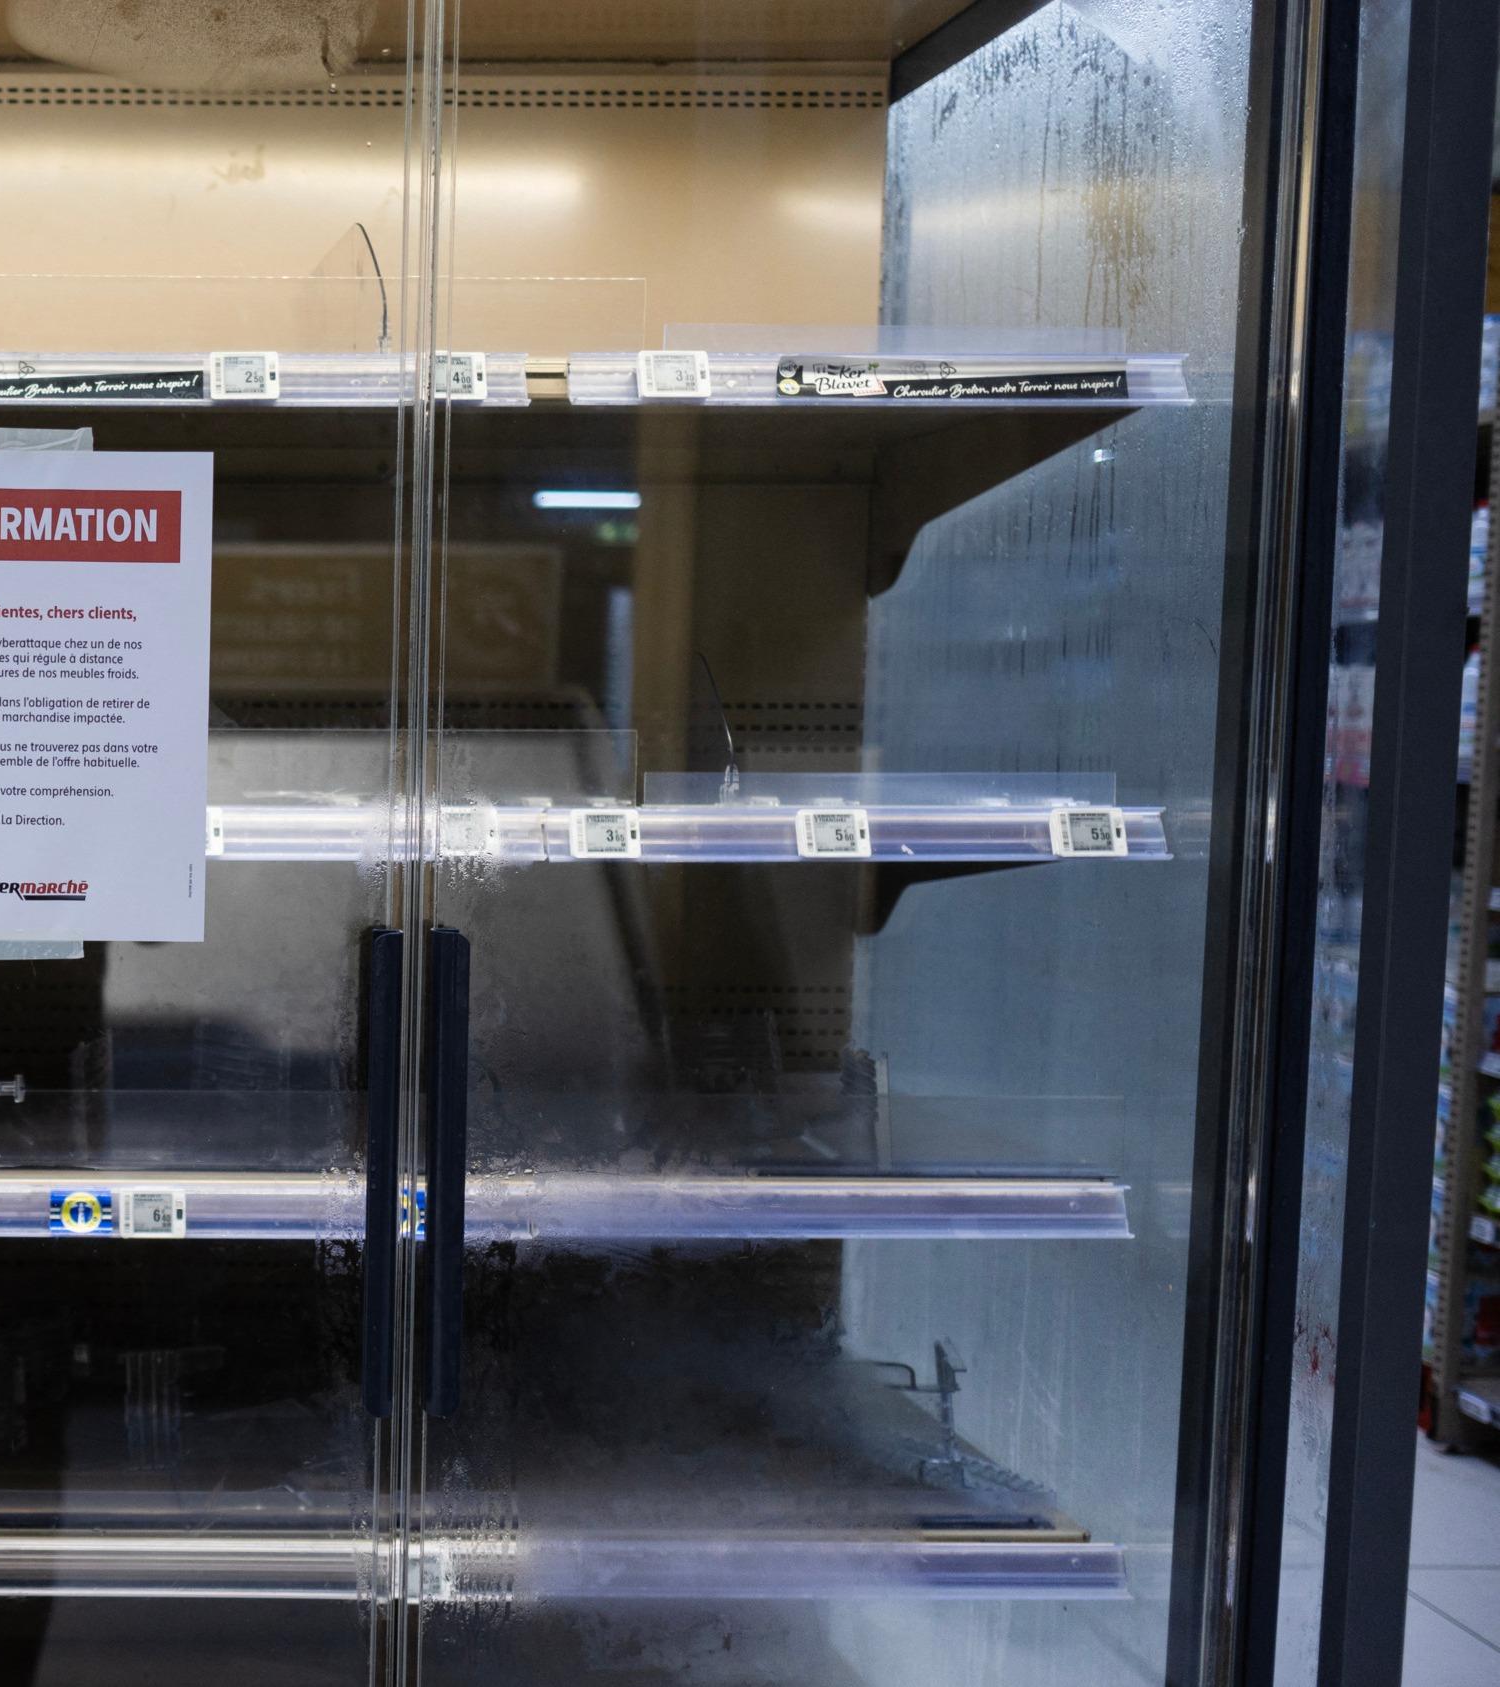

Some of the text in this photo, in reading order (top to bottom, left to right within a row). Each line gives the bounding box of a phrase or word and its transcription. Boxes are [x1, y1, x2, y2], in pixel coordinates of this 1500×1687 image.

[839, 366, 866, 379] Ker
[67, 381, 92, 394] notre
[94, 380, 128, 392] Terroir
[130, 382, 153, 391] nous
[815, 377, 871, 392] Blavet
[991, 382, 1017, 394] notre
[1018, 380, 1052, 393] Terroir
[1054, 382, 1078, 391] nous
[47, 606, 84, 619] chers
[88, 606, 136, 622] clients,
[63, 638, 89, 648] chez
[90, 641, 105, 649] un
[107, 638, 121, 649] de
[123, 641, 143, 649] nos
[12, 653, 30, 667] qui
[33, 653, 66, 667] régule
[68, 654, 77, 663] à
[79, 654, 123, 665] distance
[21, 667, 36, 678] de
[38, 670, 58, 679] nos
[60, 668, 104, 679] meubles
[107, 668, 138, 679] froids.
[85, 698, 100, 708] de
[103, 698, 134, 708] retirer
[136, 698, 151, 709] de
[2, 712, 70, 723] marchandise
[74, 712, 125, 725] impactée.
[30, 742, 79, 752] trouverez
[81, 744, 101, 755] pas
[102, 742, 130, 752] dans
[132, 744, 158, 753] votre
[35, 756, 50, 767] de
[84, 757, 140, 768] habituelle.
[0, 786, 27, 796] votre
[30, 785, 113, 798] compréhension.
[0, 814, 65, 826] La Direction.
